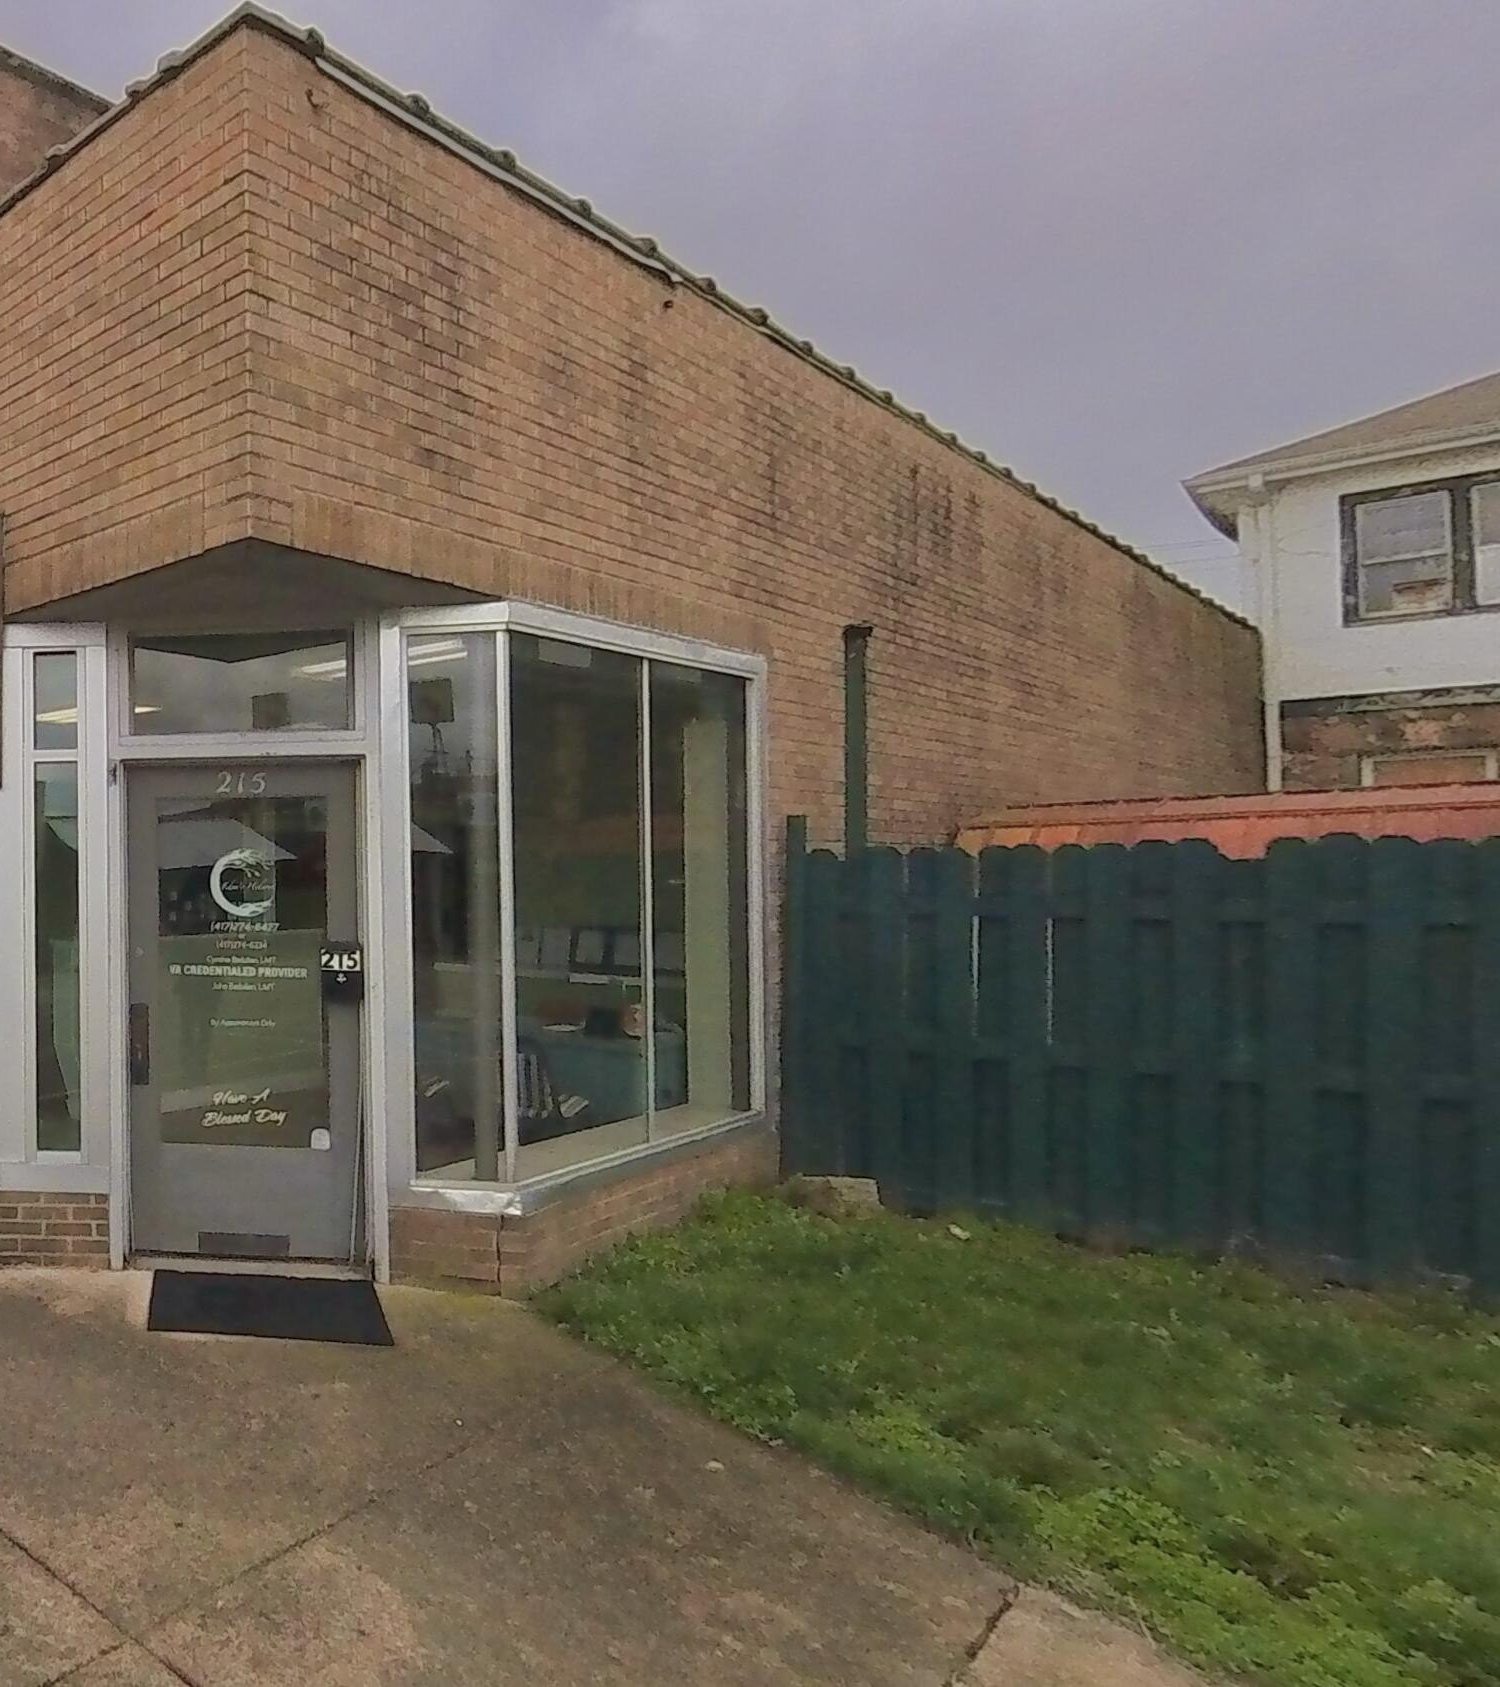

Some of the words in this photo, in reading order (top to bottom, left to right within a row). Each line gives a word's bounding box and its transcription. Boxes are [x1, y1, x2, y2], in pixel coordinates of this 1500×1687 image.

[215, 770, 267, 795] 215
[320, 950, 358, 970] 215
[183, 965, 257, 977] CREDENTIALED
[258, 967, 308, 979] PROVIDER
[212, 1089, 248, 1106] Have
[251, 1087, 271, 1105] A
[201, 1109, 252, 1127] Blessed
[253, 1108, 288, 1127] Day
